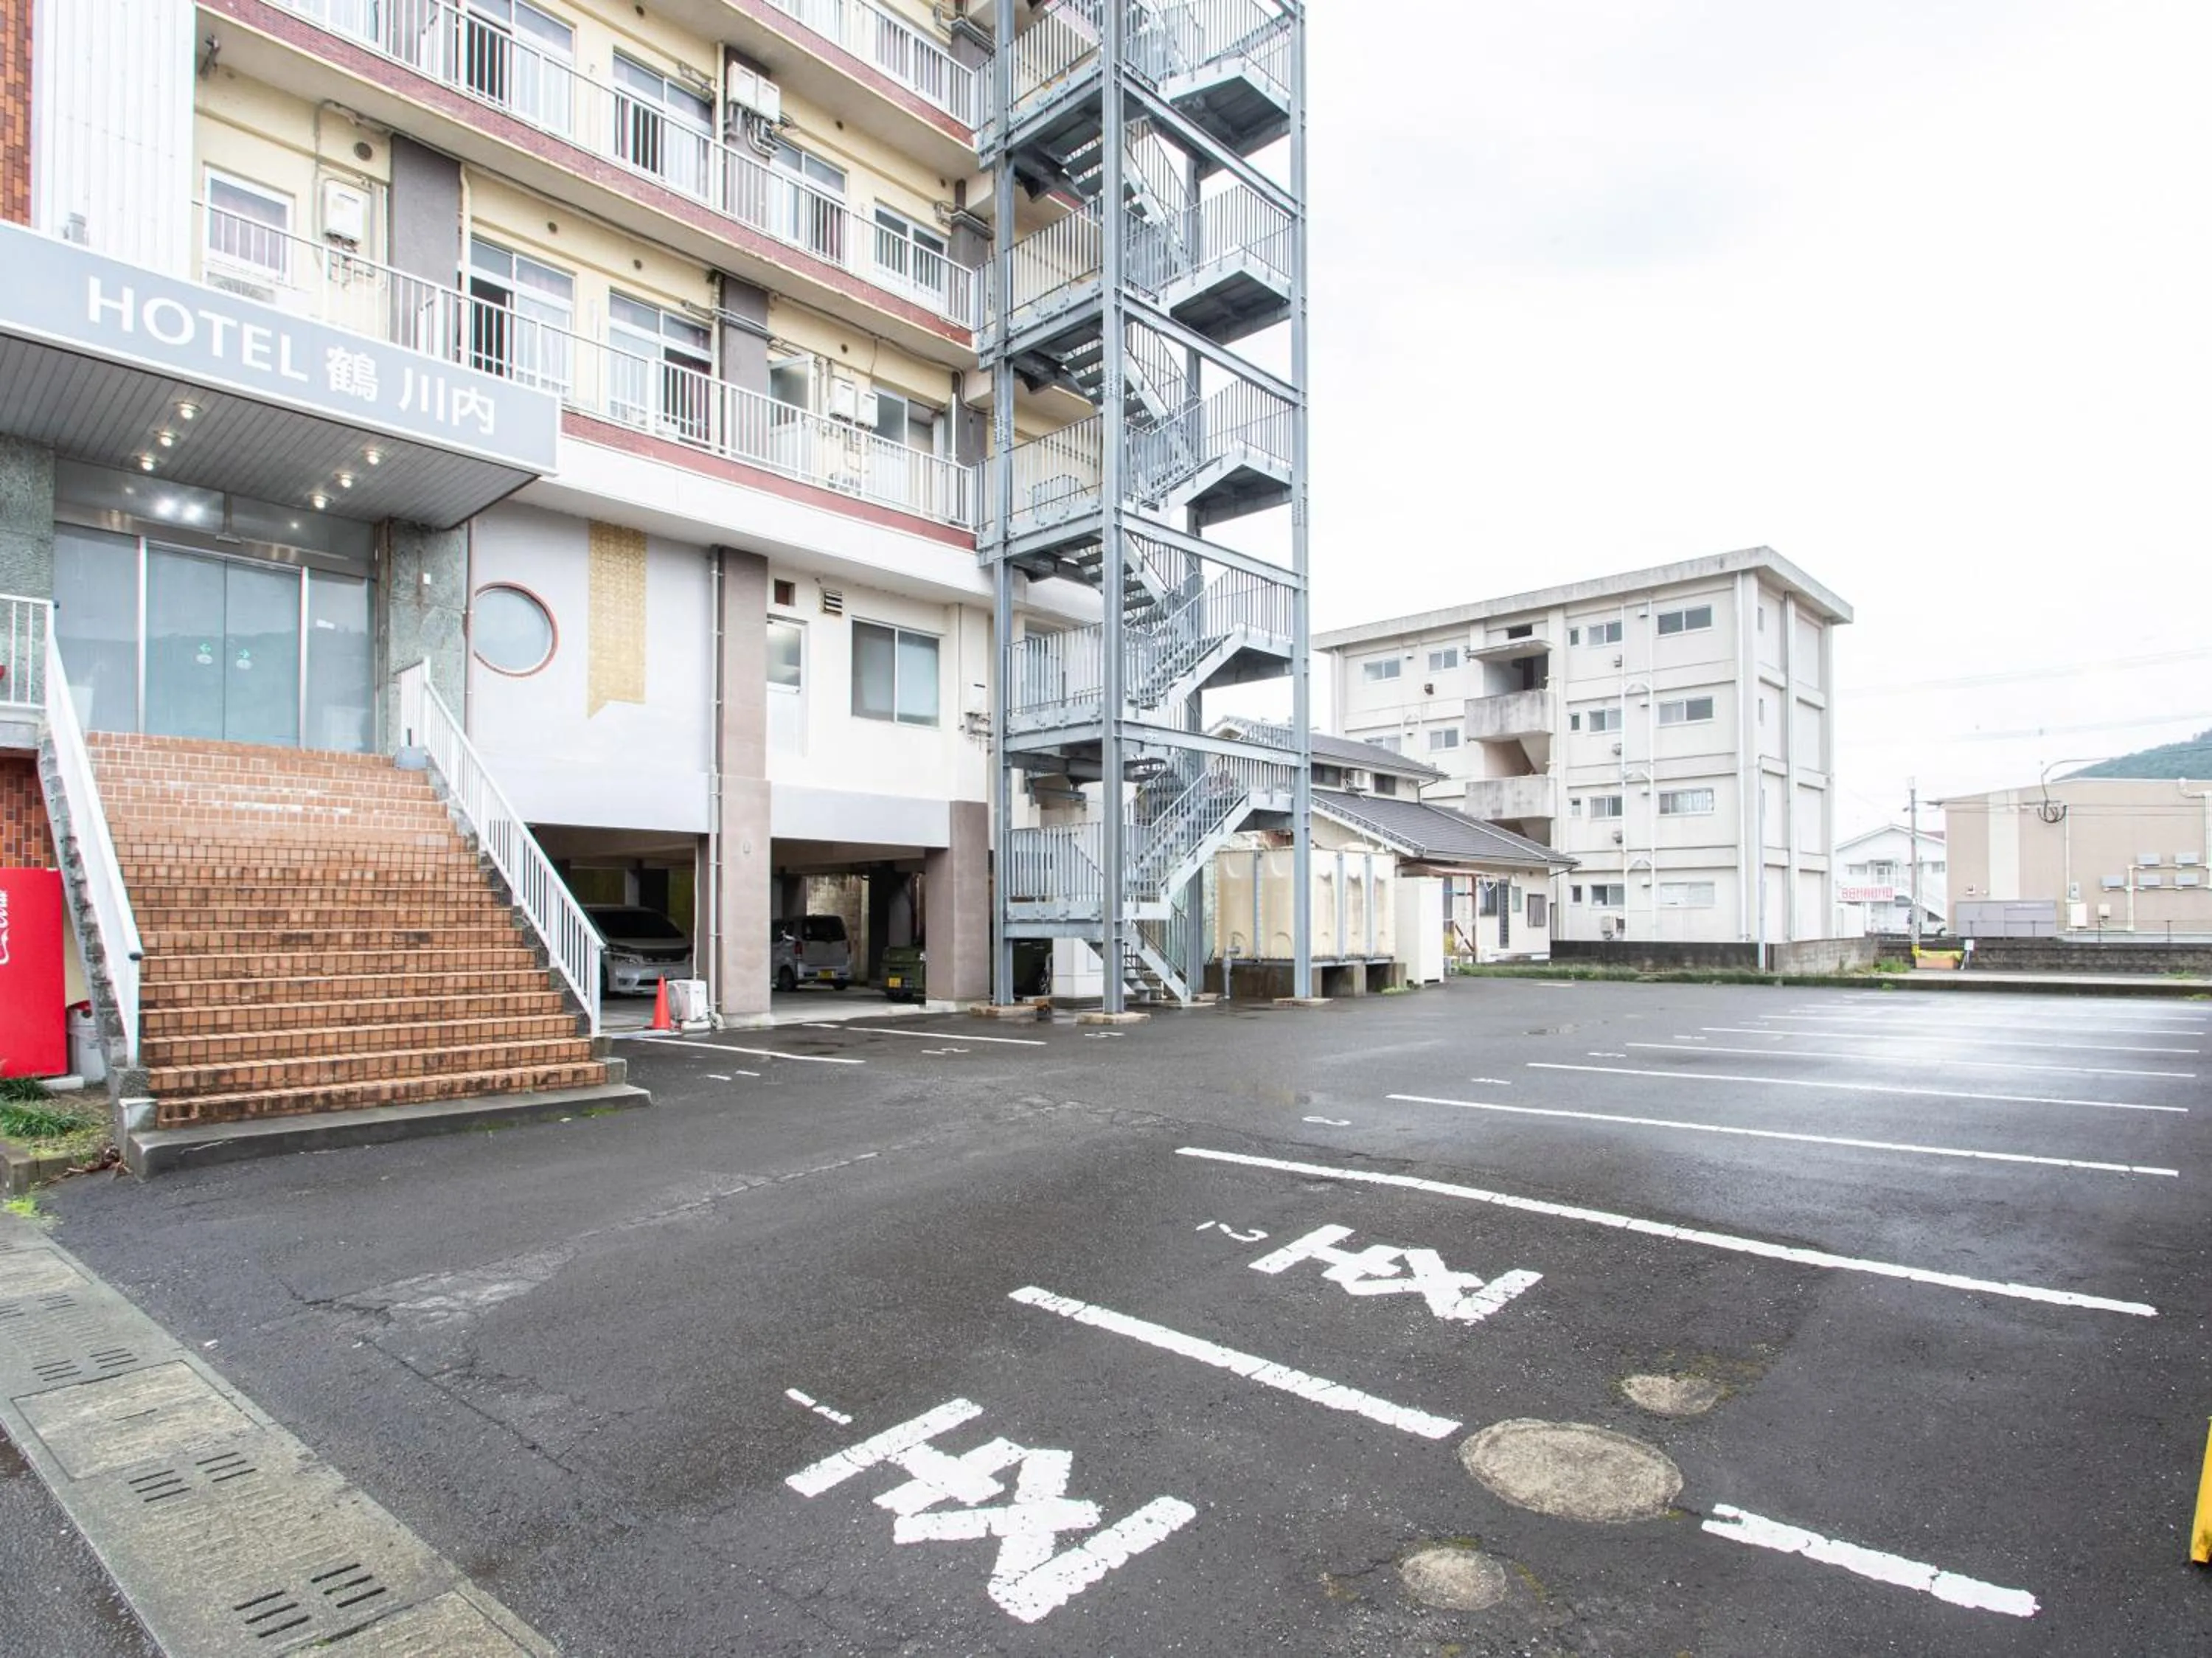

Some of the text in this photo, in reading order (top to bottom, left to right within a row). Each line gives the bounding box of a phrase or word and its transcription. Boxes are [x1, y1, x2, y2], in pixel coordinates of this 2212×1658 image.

[88, 277, 495, 435] HOTEL 鶴 川内
